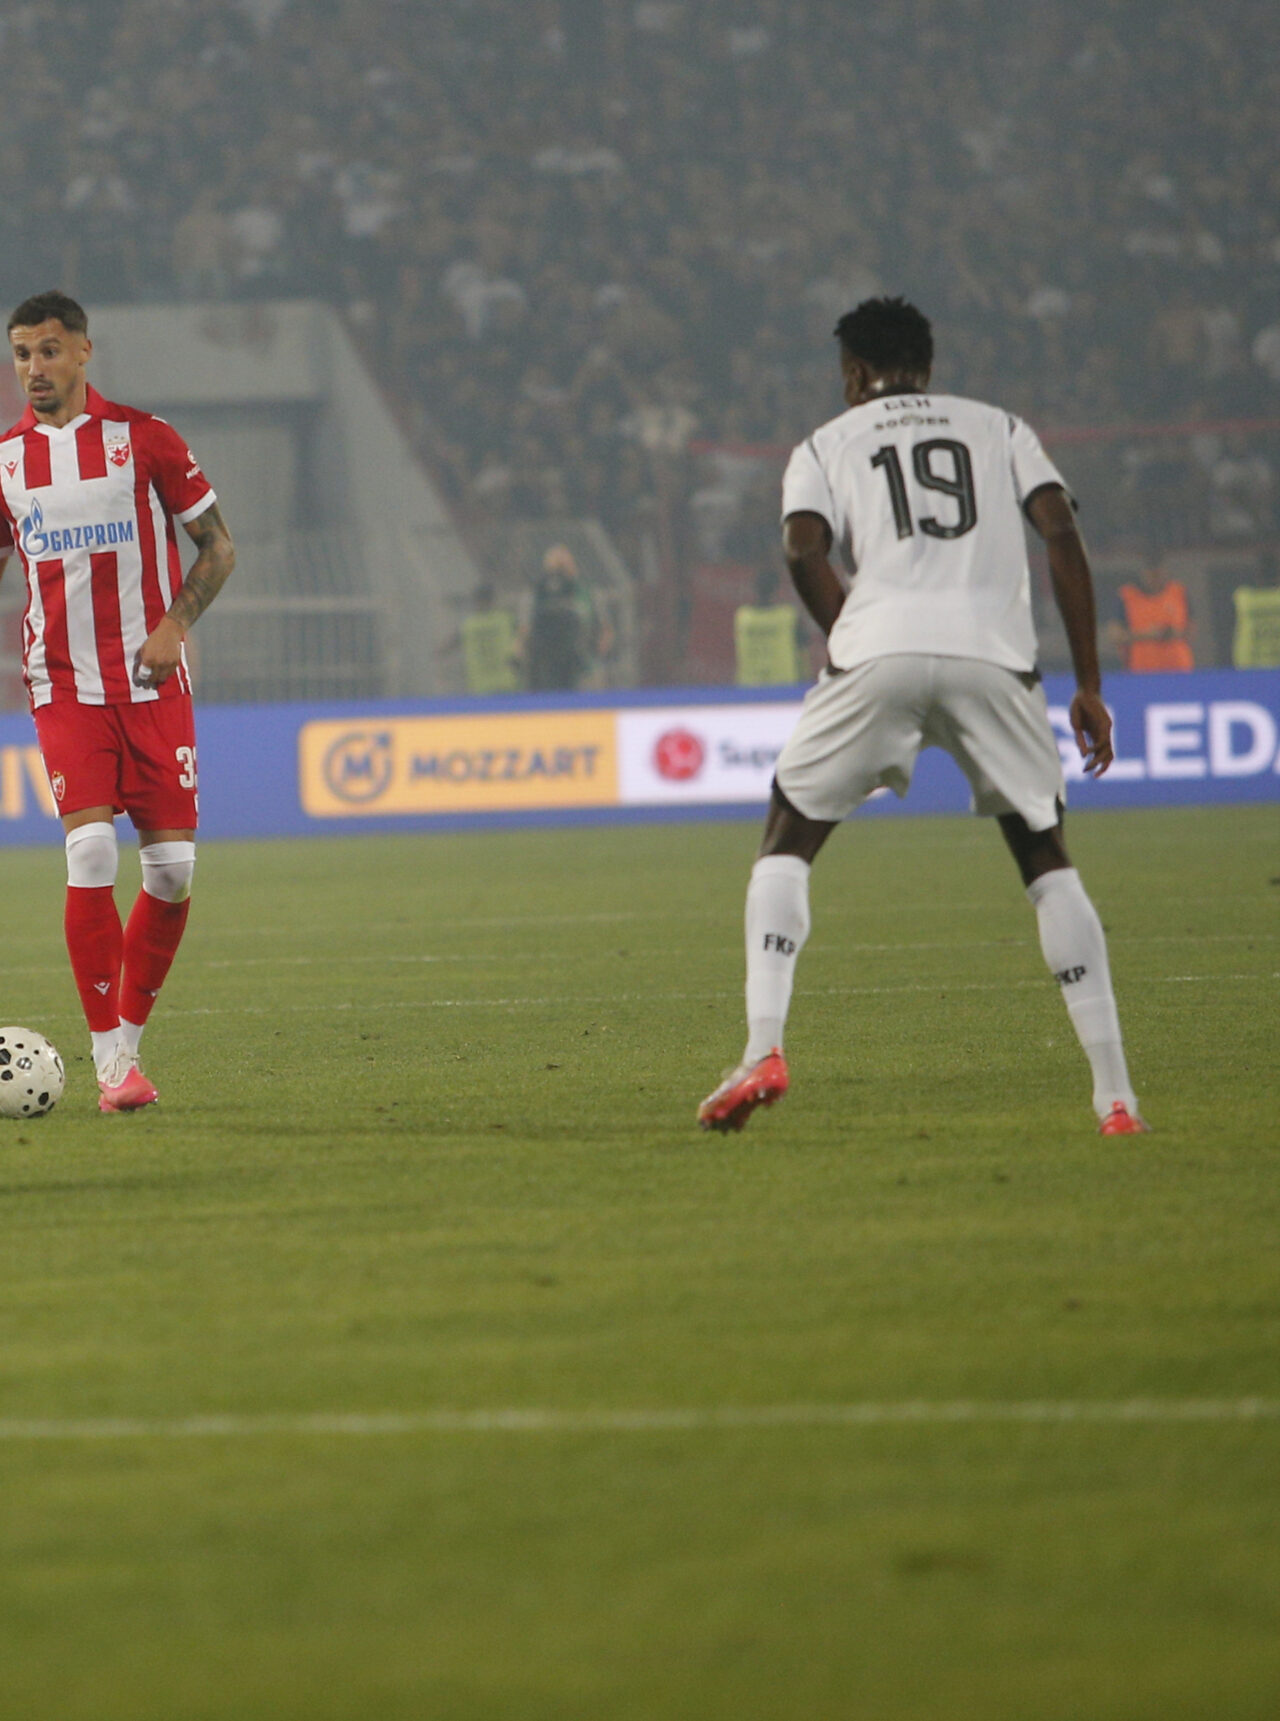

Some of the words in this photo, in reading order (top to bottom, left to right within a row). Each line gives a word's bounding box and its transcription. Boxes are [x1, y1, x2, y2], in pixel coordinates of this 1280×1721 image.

[870, 438, 978, 541] 19
[50, 520, 134, 552] GAZPROM
[1047, 700, 1280, 781] GLED
[176, 746, 198, 791] 3
[410, 745, 600, 785] MOZZART
